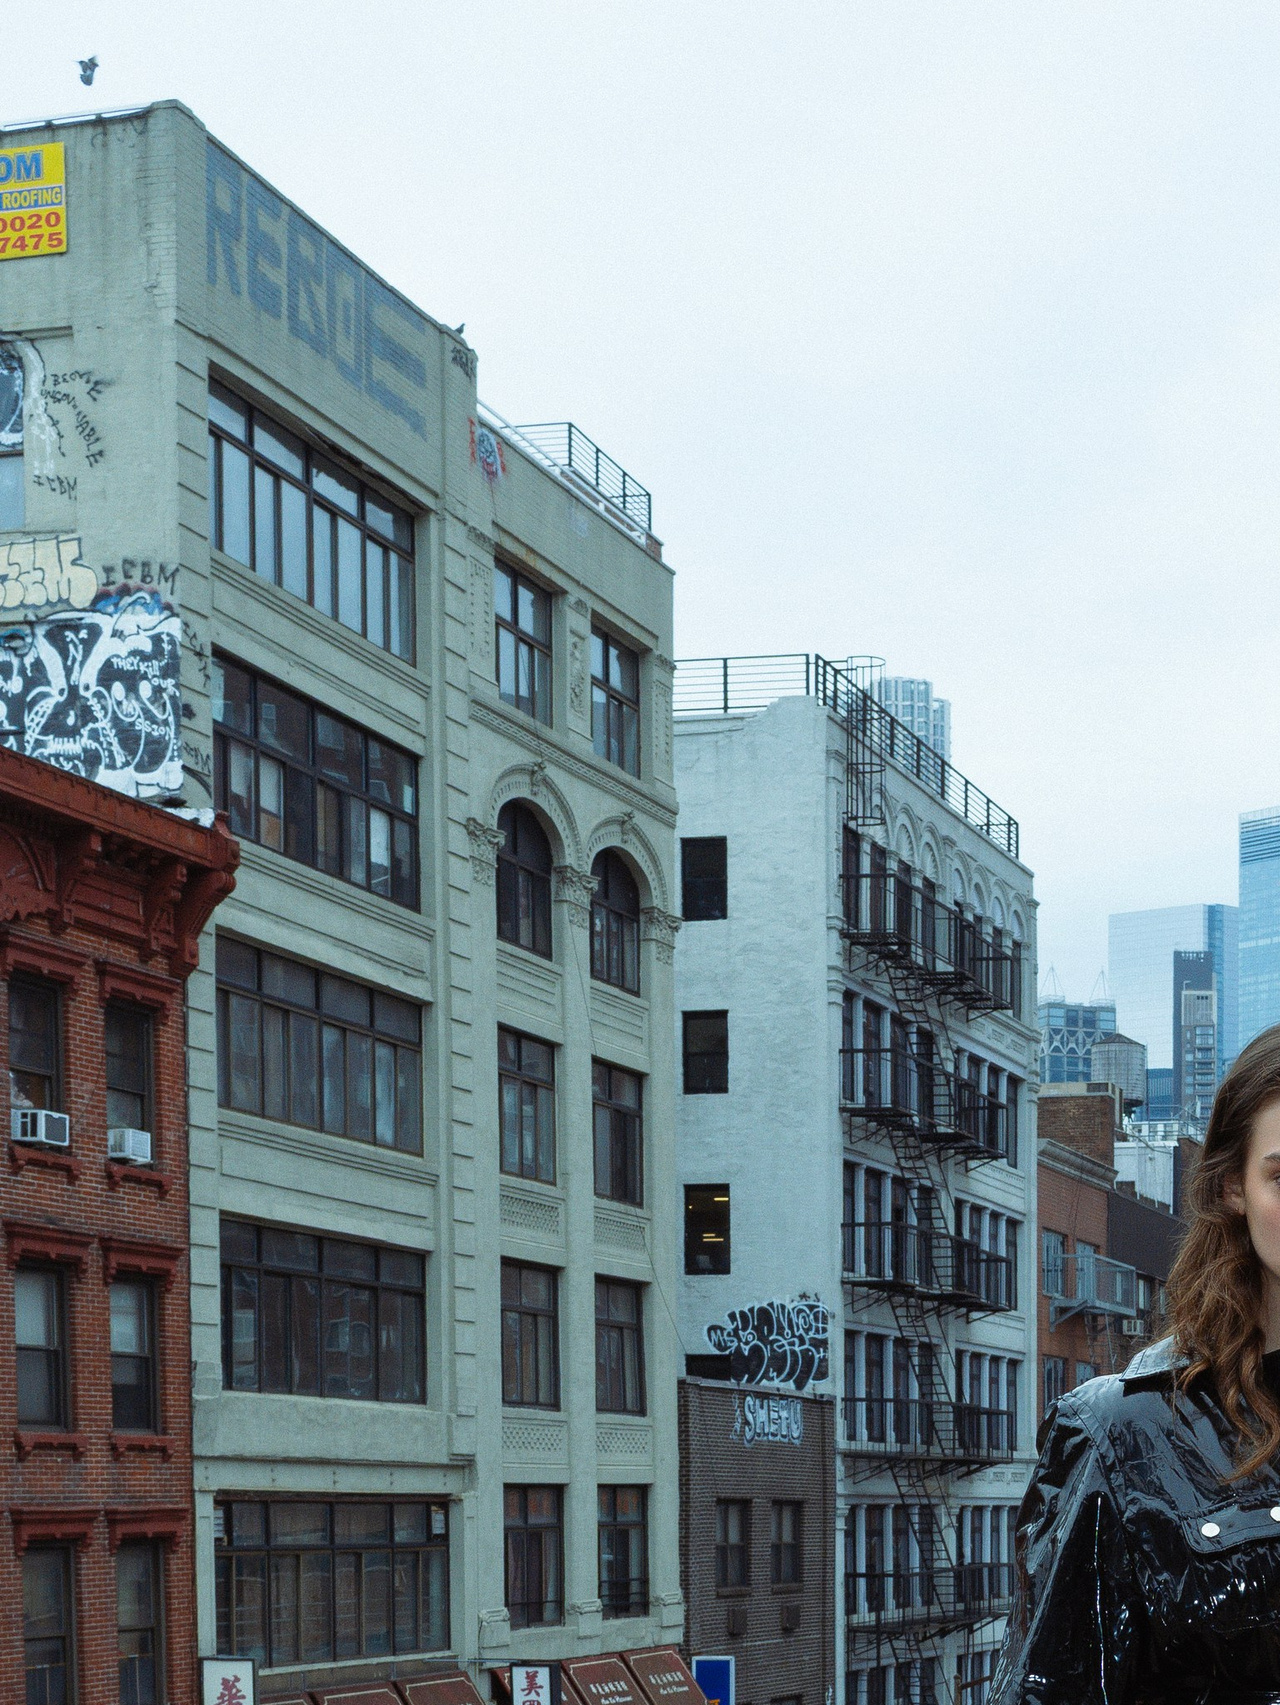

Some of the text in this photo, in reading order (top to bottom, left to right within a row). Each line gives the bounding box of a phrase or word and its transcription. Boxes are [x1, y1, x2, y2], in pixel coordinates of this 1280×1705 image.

[2, 187, 61, 209] ROOFING
[0, 231, 64, 254] 7475
[111, 656, 140, 672] THEY
